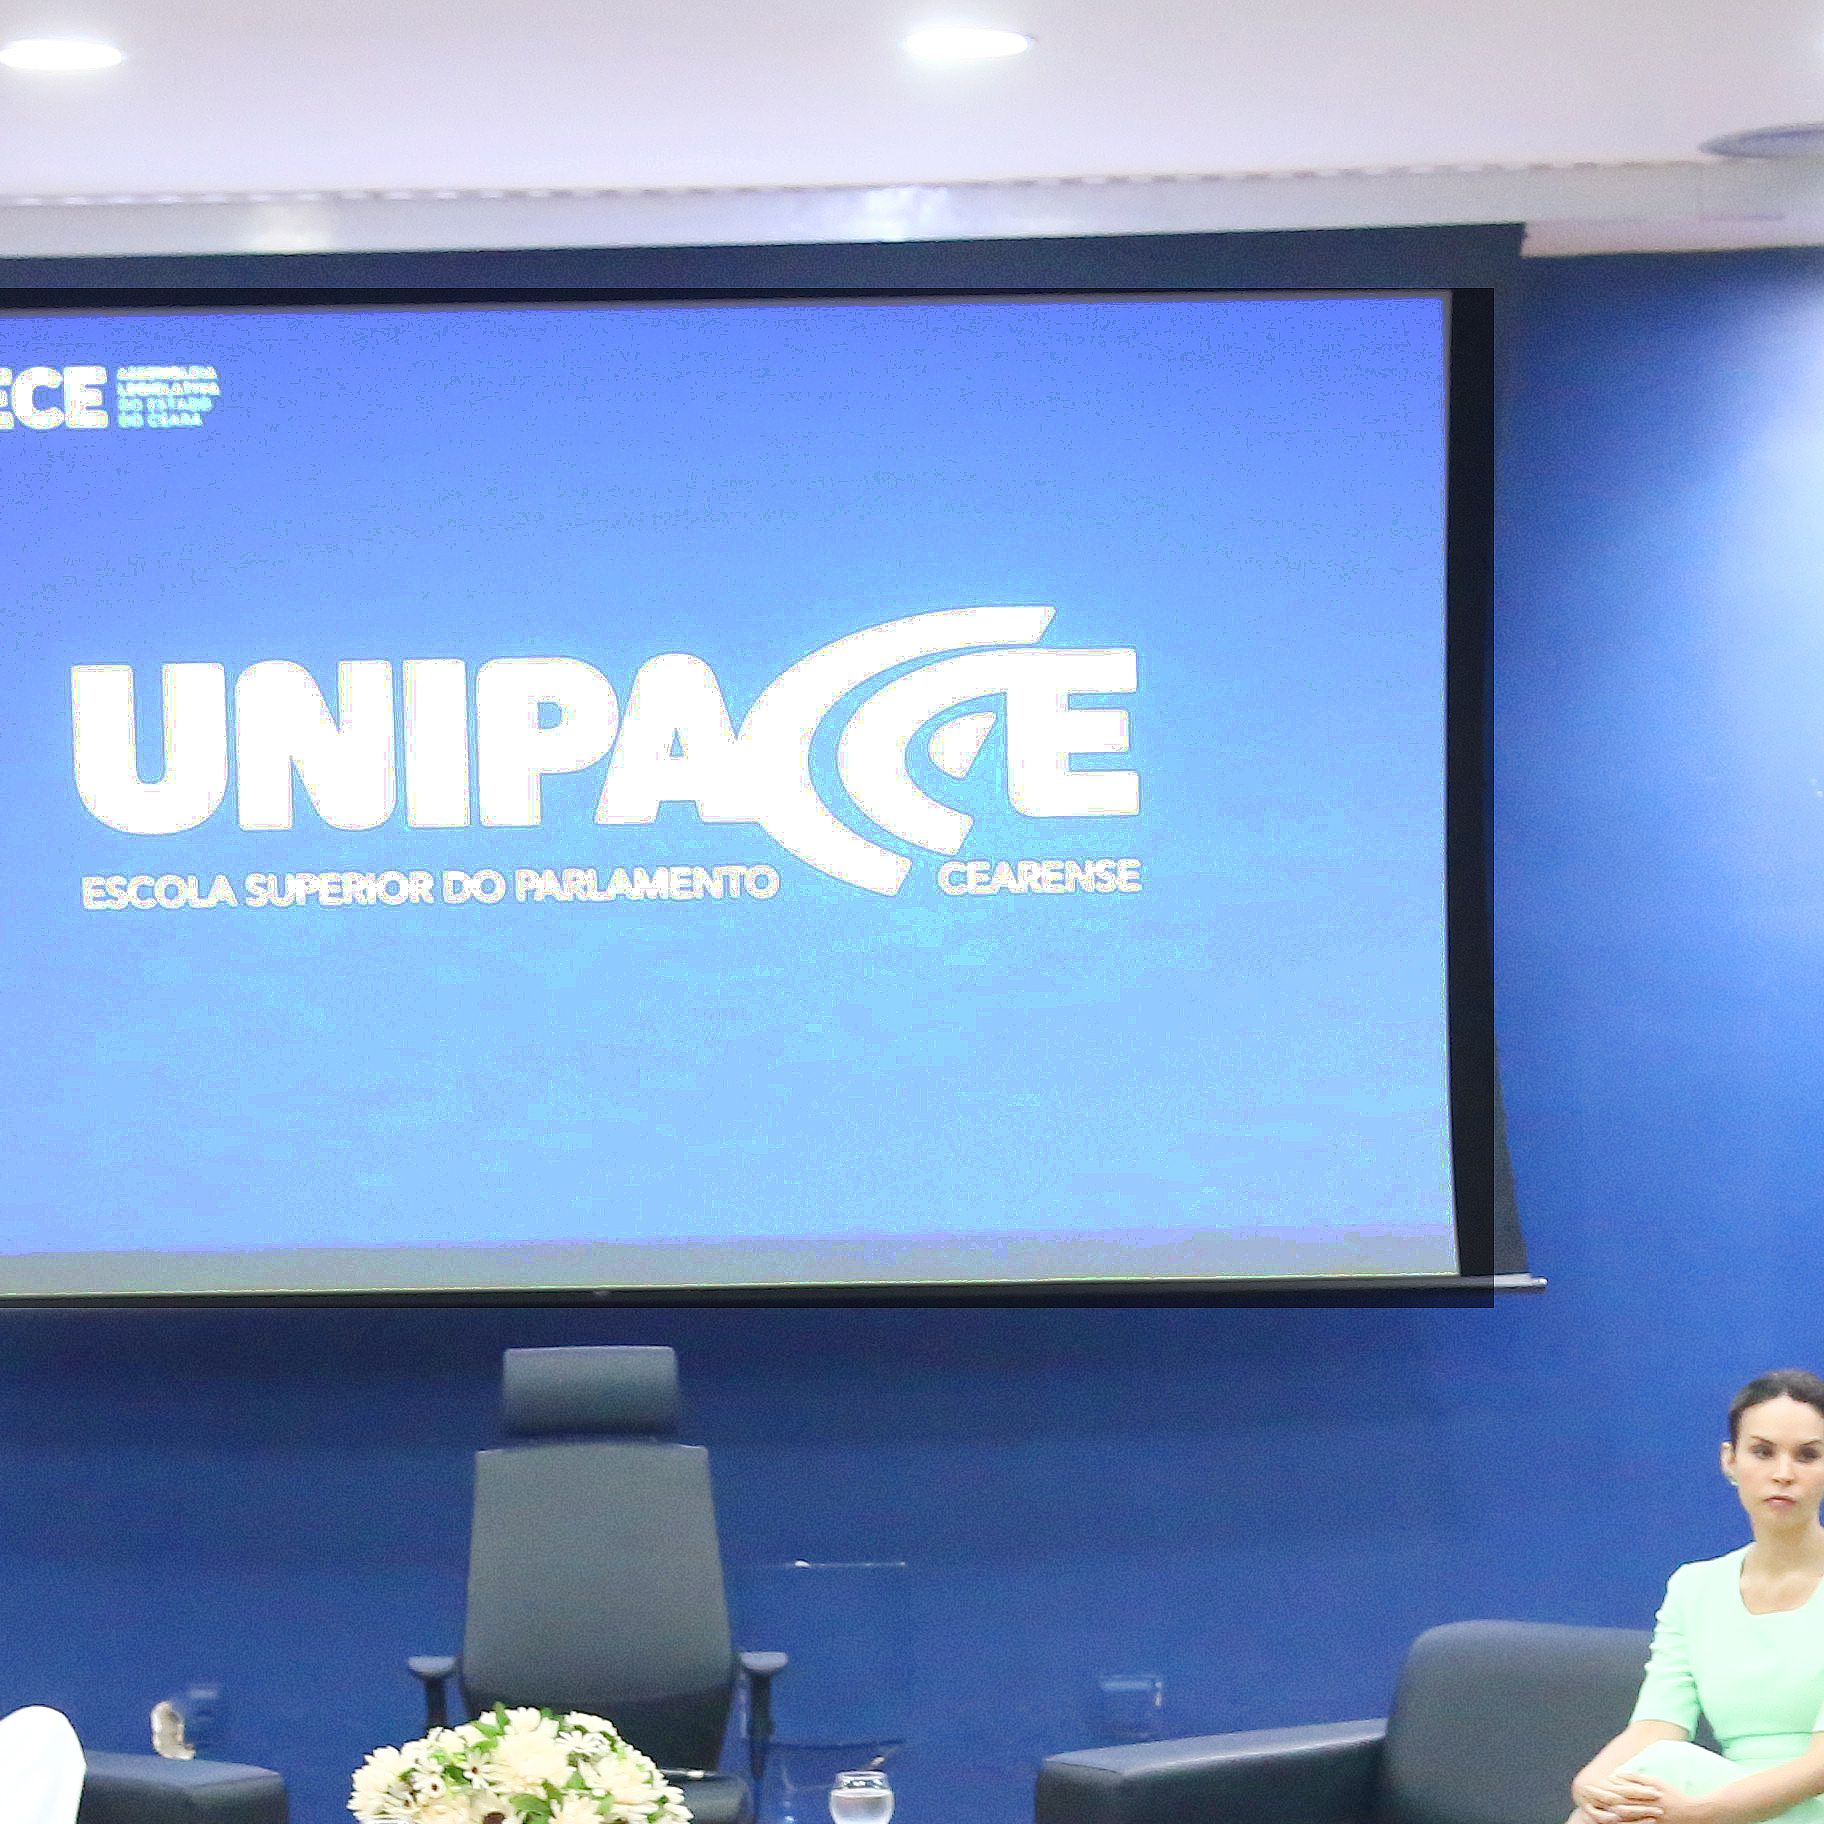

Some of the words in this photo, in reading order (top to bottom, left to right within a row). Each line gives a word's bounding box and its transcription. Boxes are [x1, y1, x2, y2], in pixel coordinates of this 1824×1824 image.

[82, 874, 237, 910] ESCOLA
[245, 870, 435, 907] SUPERIOR
[442, 869, 506, 904] DO
[515, 865, 780, 902] PARLAMENTO
[938, 858, 1142, 895] CEARENSE
